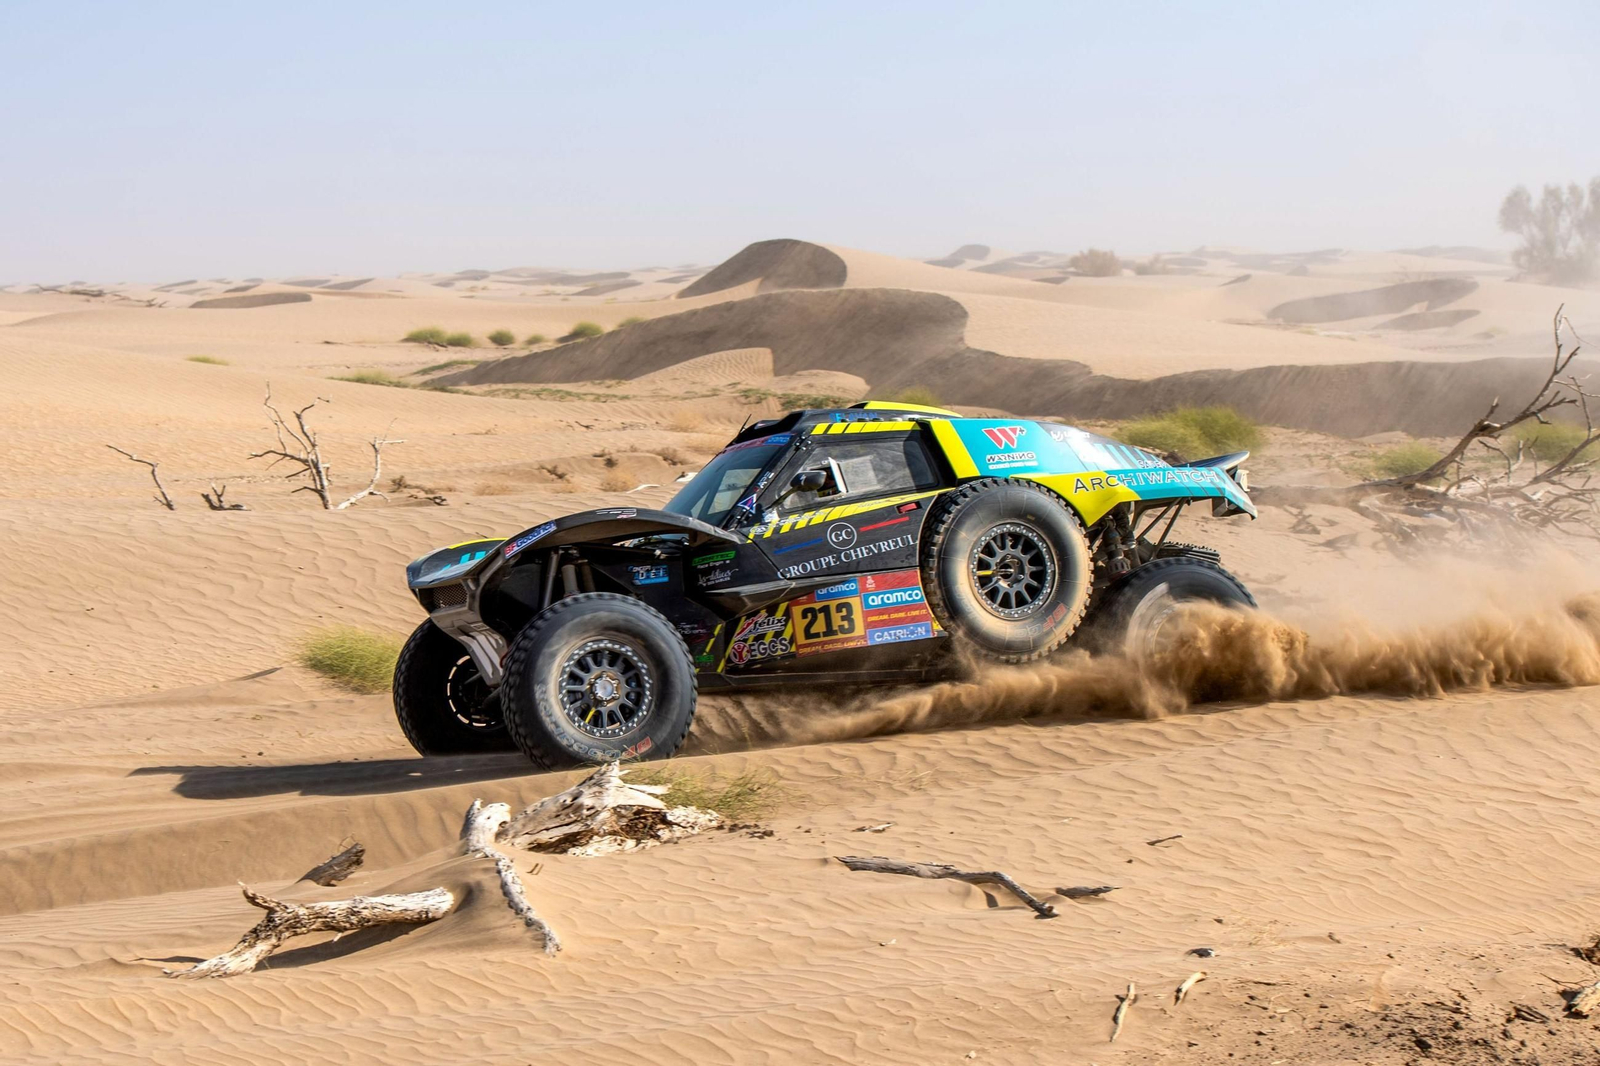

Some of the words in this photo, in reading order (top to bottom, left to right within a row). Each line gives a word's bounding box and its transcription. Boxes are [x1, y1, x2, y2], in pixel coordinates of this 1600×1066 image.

[1073, 469, 1220, 494] ARCHIWATCH
[831, 528, 853, 543] GC
[777, 553, 840, 580] GROUPE
[841, 534, 918, 563] CHEVREUL
[818, 580, 857, 595] aramco
[868, 589, 922, 606] aramco
[801, 601, 855, 641] 213
